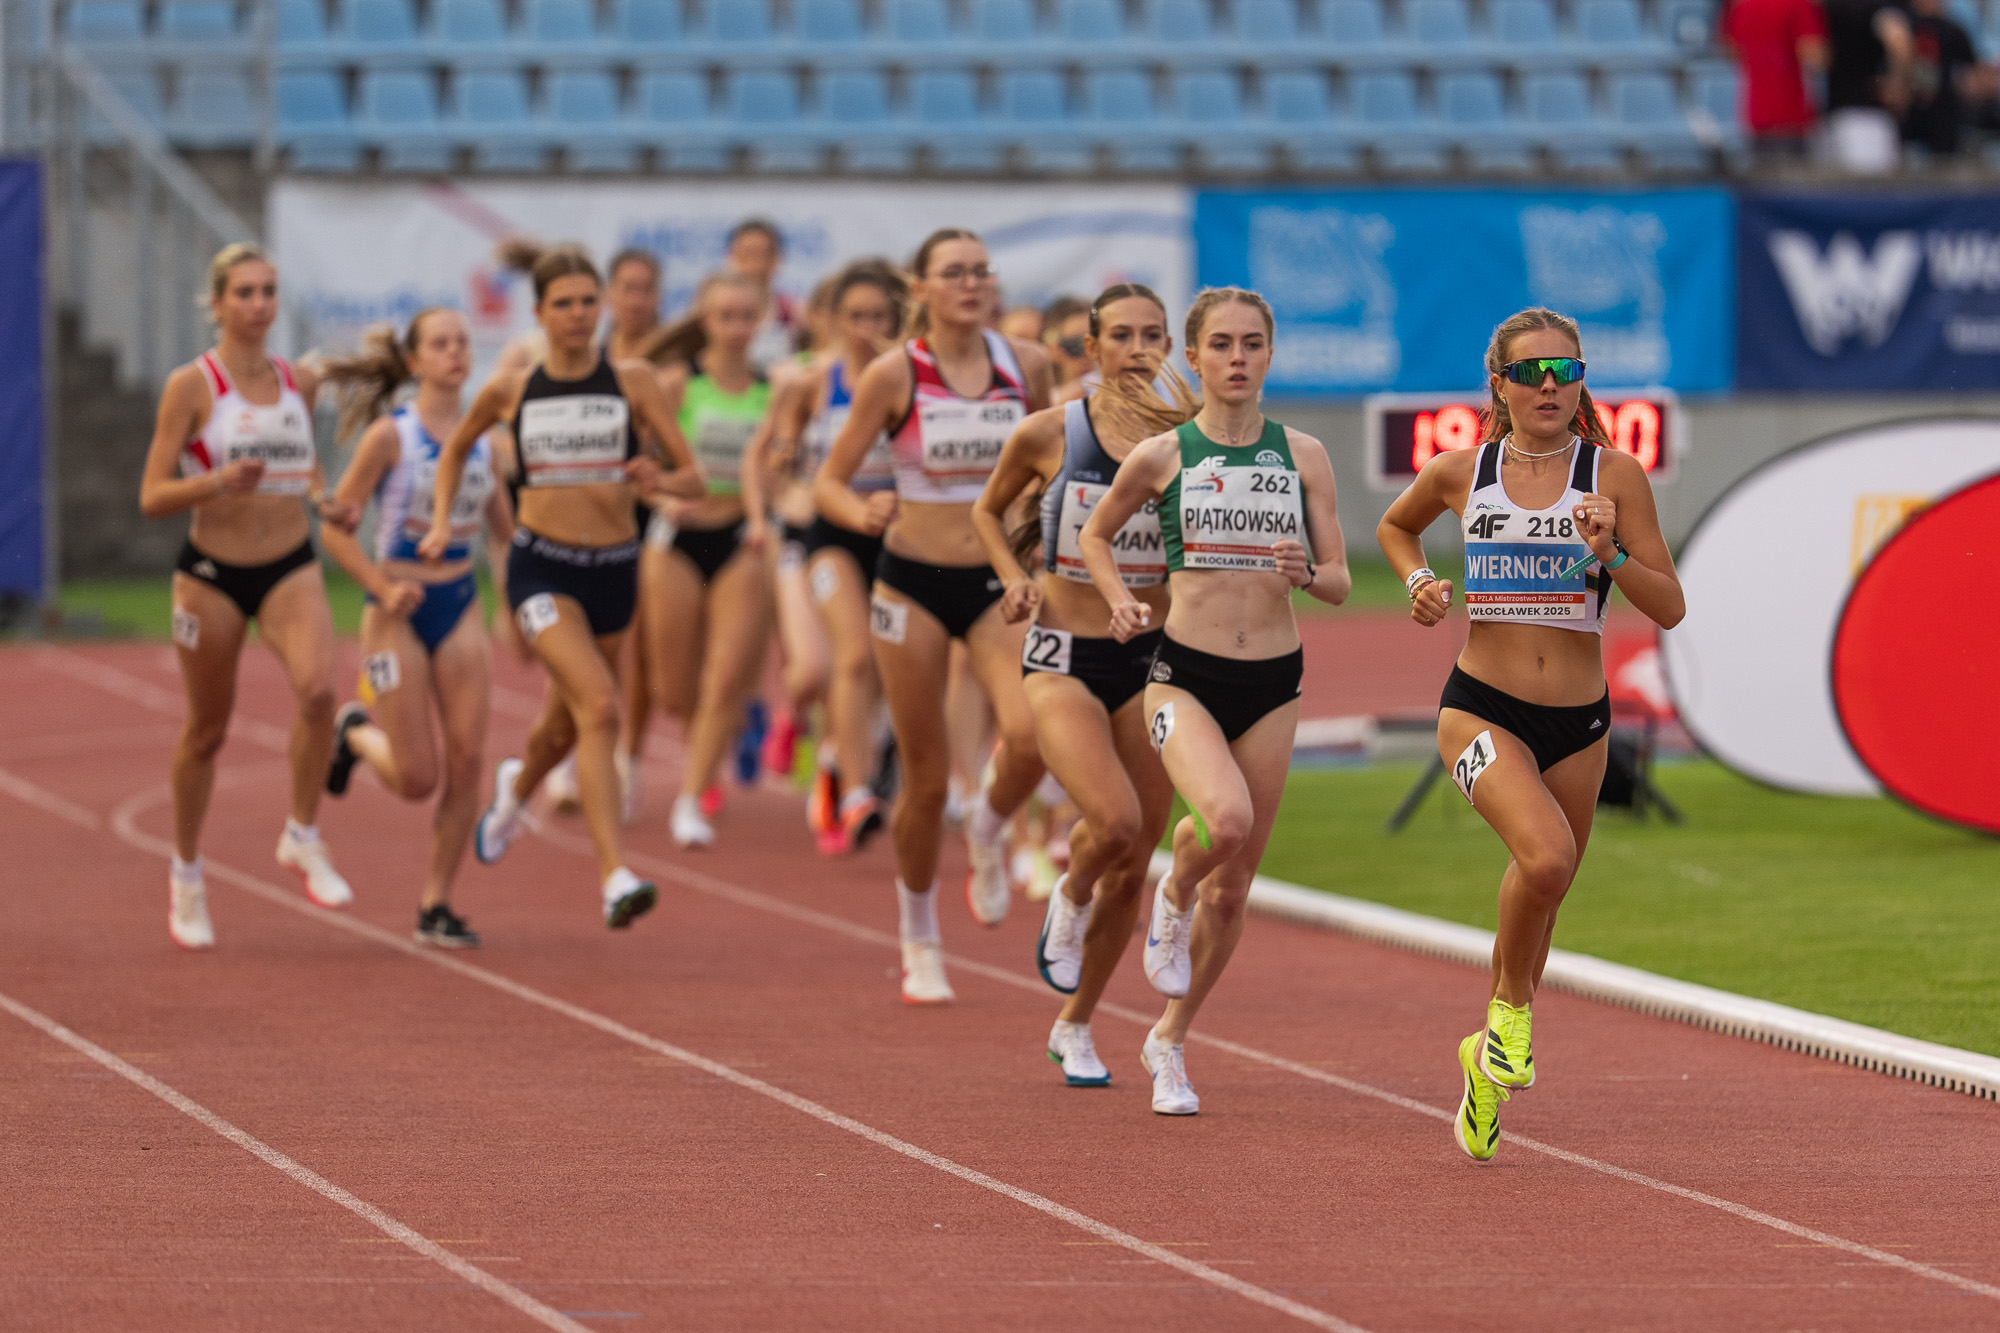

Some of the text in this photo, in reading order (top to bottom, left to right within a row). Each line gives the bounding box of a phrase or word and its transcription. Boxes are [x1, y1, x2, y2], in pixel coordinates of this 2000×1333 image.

[1250, 473, 1291, 494] 262
[1184, 508, 1297, 535] PIĄTKOWSKA
[1468, 513, 1511, 539] 4F
[1526, 516, 1573, 538] 218
[1194, 555, 1277, 569] WŁOCŁAWEK 202
[1477, 594, 1494, 602] PZLA
[1494, 594, 1537, 602] Mistrzostwa
[1538, 594, 1559, 602] Polski
[1559, 594, 1574, 602] U20
[1470, 606, 1571, 616] WŁOCŁAWEK 2025
[1027, 630, 1061, 669] 22
[1456, 738, 1489, 797] 24
